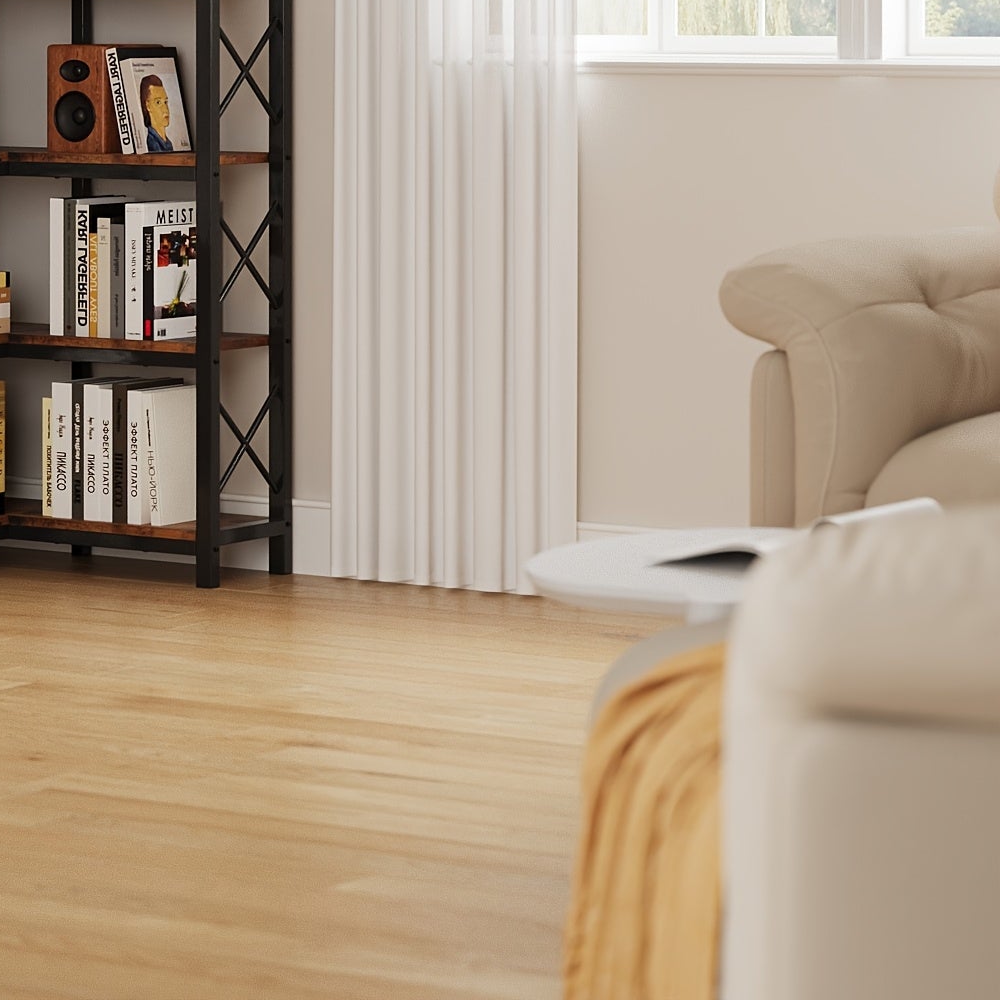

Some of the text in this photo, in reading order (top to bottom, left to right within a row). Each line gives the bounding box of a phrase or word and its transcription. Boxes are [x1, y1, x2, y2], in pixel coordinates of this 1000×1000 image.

[56, 451, 66, 491] ПИКАССО
[87, 453, 95, 494] ПИКАССО
[147, 450, 158, 512] НЬЮ-ЙОРК
